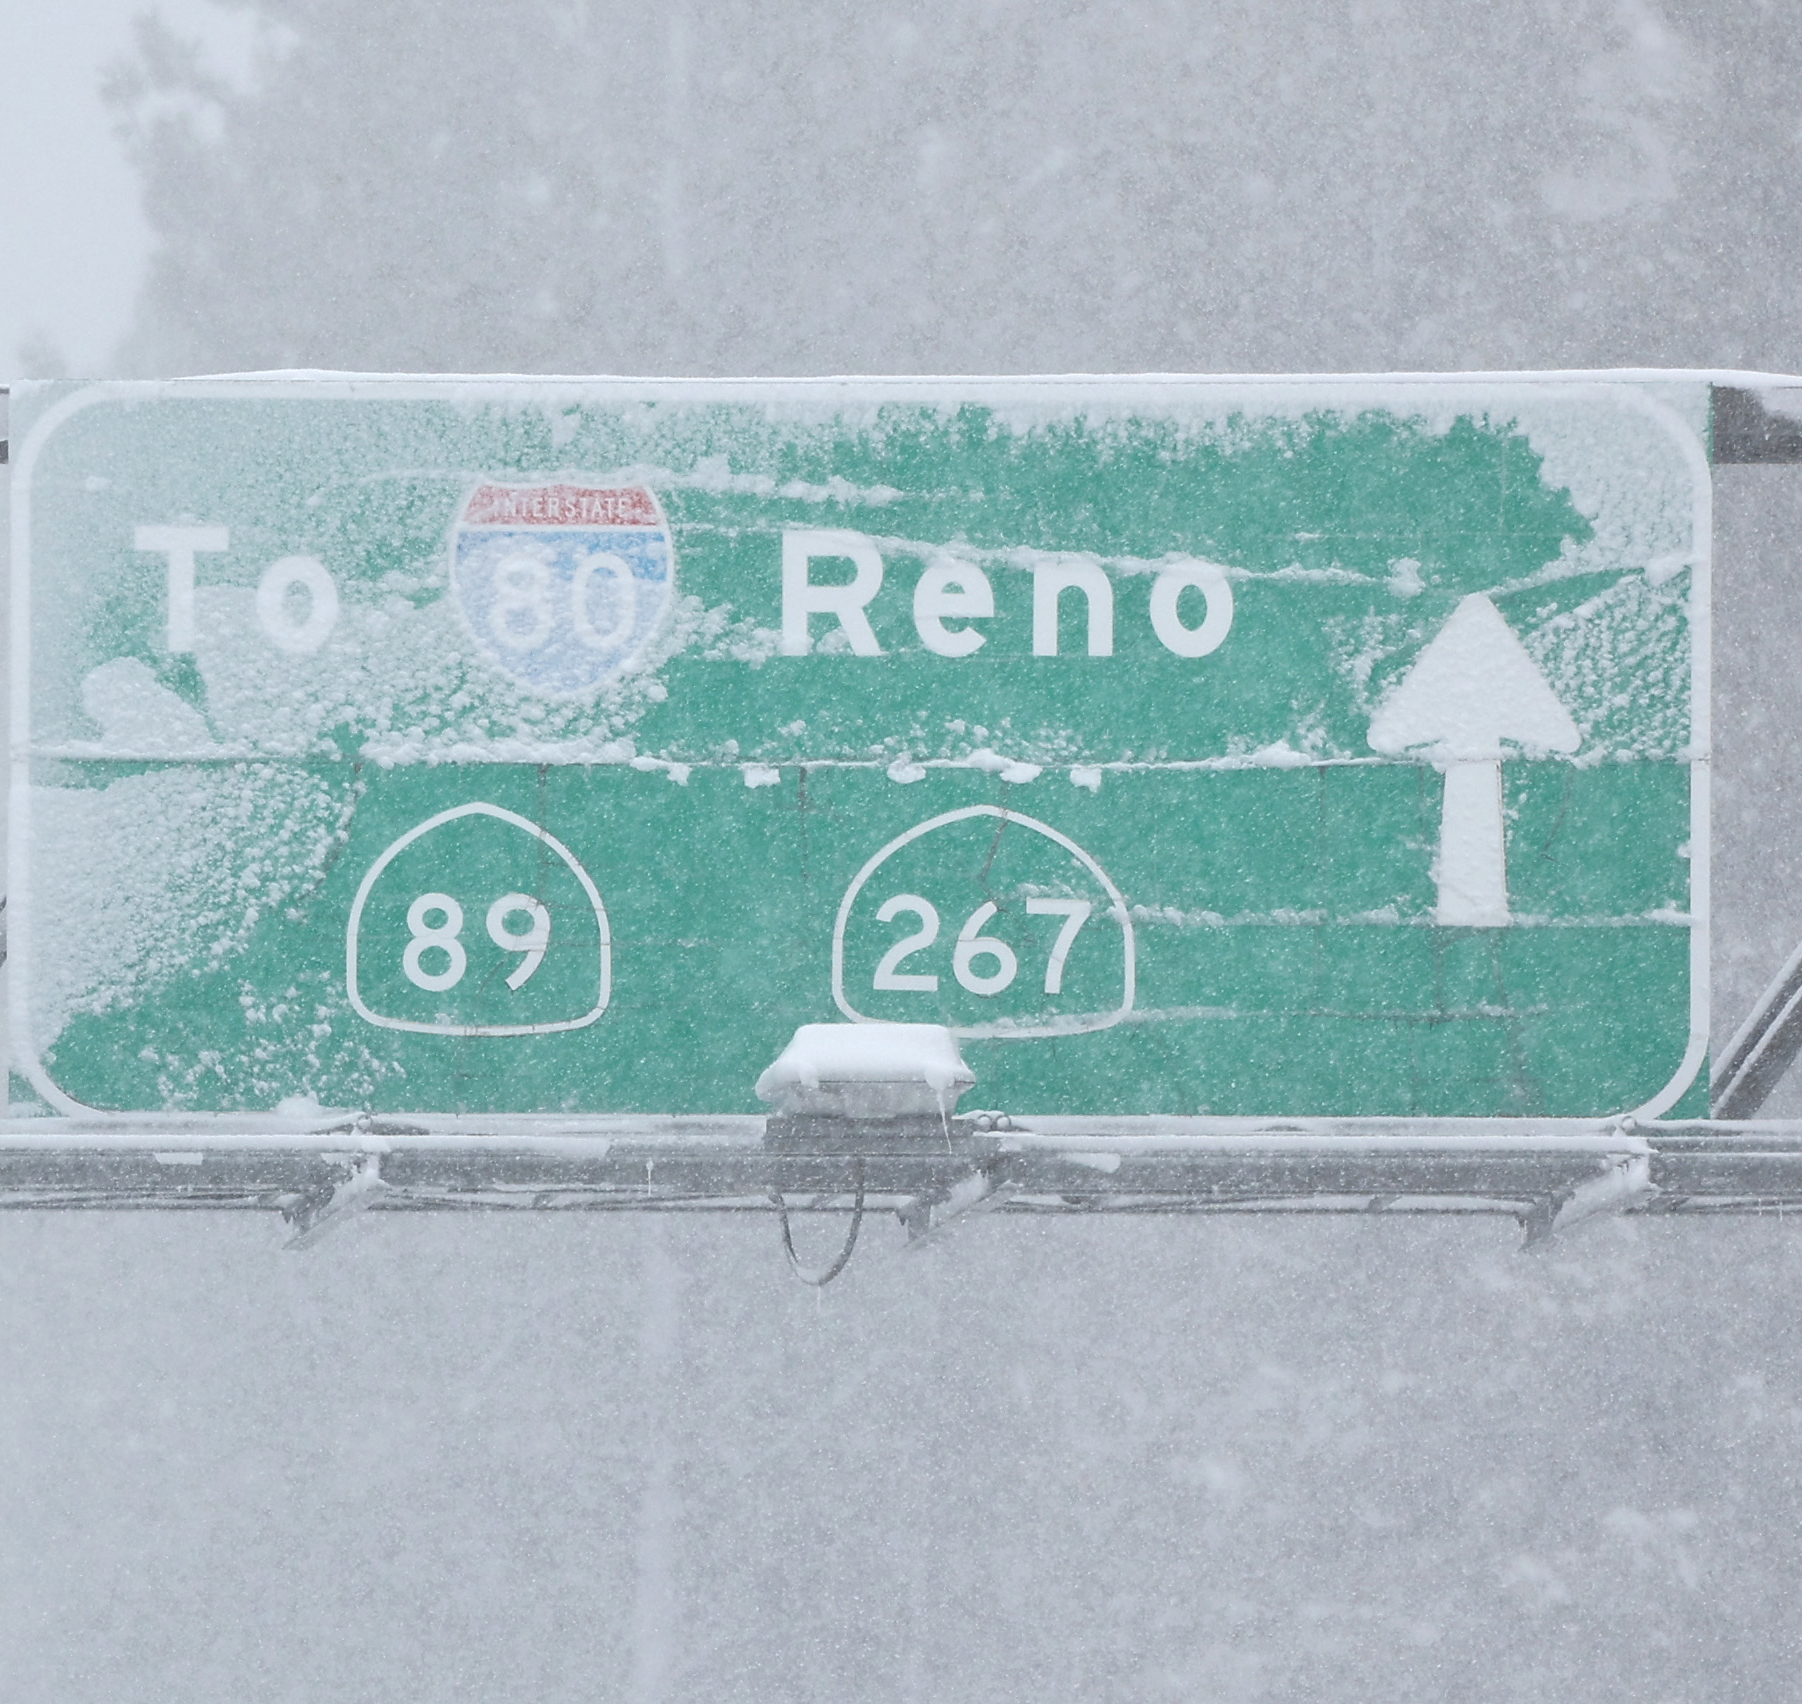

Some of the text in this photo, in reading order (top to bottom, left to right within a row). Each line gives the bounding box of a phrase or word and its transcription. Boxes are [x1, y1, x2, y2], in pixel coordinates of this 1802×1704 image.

[494, 497, 632, 519] INTERSTATE
[134, 526, 1235, 658] To 80 Reno
[402, 893, 552, 992] 89
[872, 893, 1092, 997] 267
